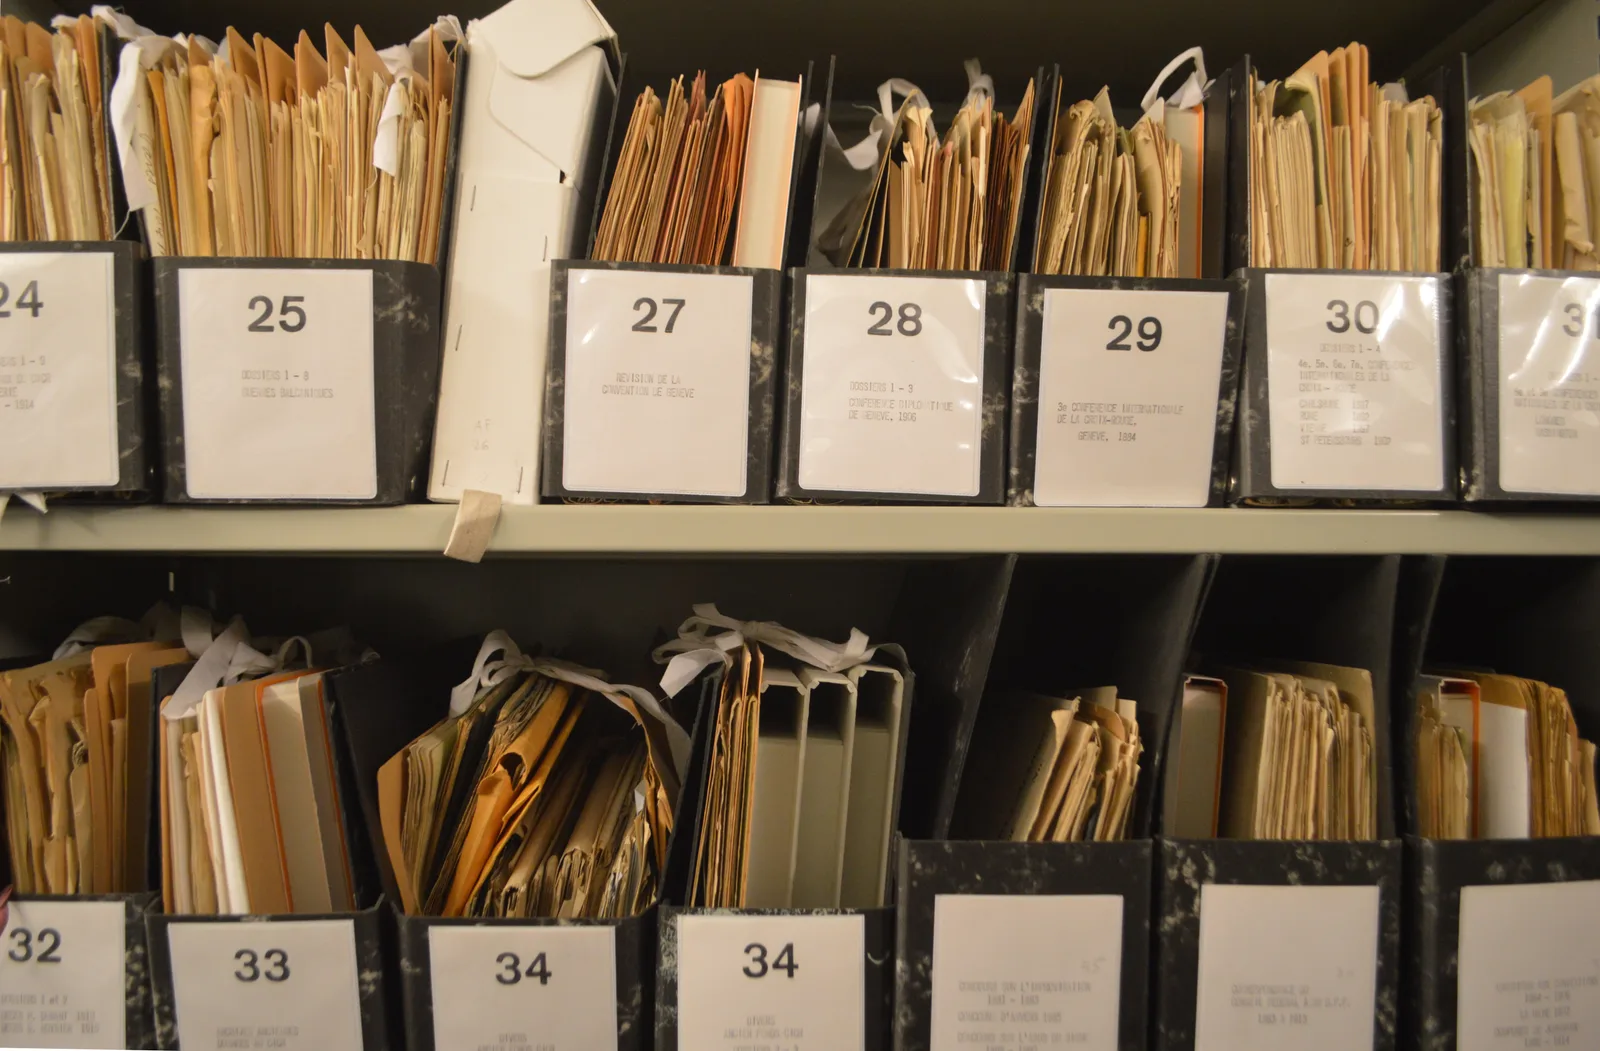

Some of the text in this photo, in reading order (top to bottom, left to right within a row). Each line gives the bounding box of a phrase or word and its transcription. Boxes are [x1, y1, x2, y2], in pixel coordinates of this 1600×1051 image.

[248, 295, 307, 333] 25
[631, 297, 686, 334] 27
[867, 301, 922, 337] 28
[1326, 299, 1379, 335] 30
[1106, 315, 1163, 352] 29
[602, 384, 649, 396] CONVENTION
[666, 388, 695, 399] GENEVE
[616, 372, 681, 385] REVISION DE LA
[849, 381, 887, 392] DOSSIERS
[908, 384, 913, 393] 3
[848, 398, 895, 409] CONFERENCE
[848, 410, 858, 420] DE
[898, 411, 917, 422] 1906
[1057, 401, 1184, 415] 3e CONFERENCE INTERNATIONALE
[1057, 414, 1067, 424] DE
[8, 928, 61, 963] 32
[742, 943, 799, 979] 34
[234, 949, 290, 982] 33
[496, 952, 552, 985] 34
